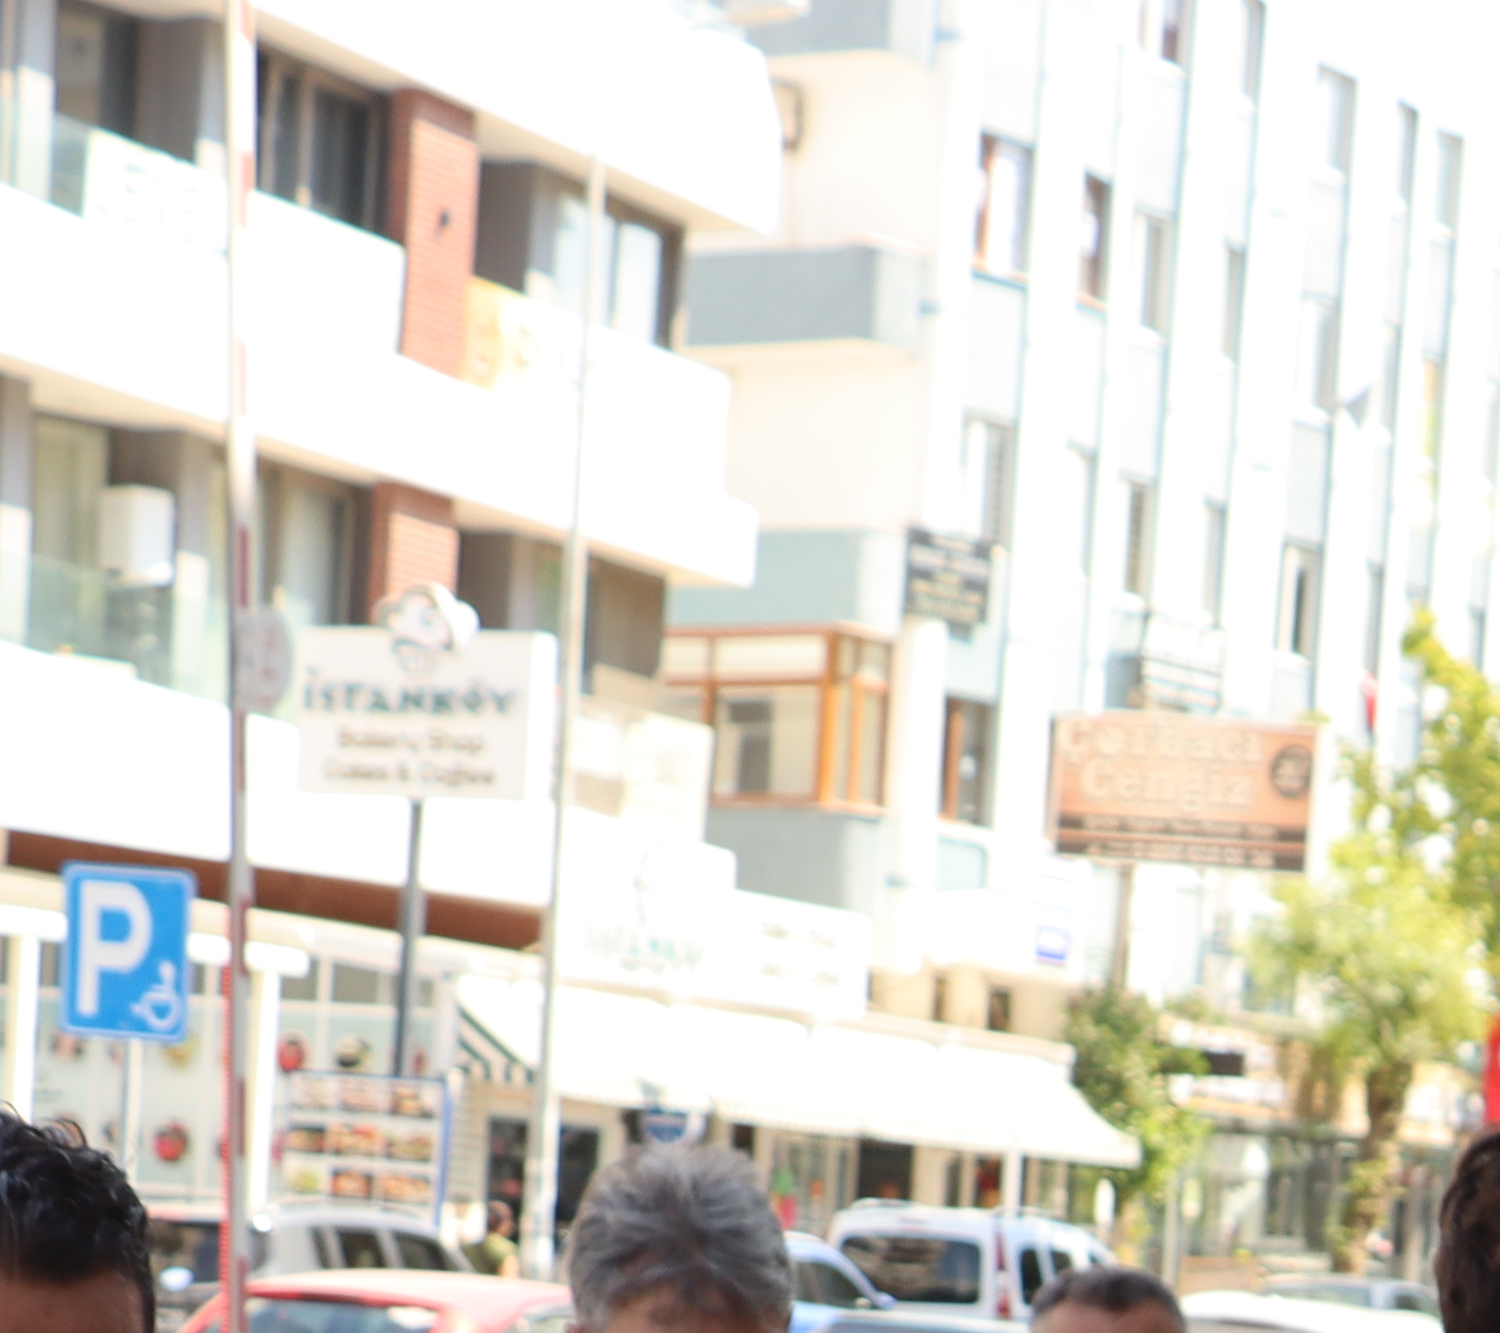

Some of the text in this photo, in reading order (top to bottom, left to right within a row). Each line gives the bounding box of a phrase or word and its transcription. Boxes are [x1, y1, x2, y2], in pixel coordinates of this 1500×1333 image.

[303, 667, 517, 714] İSTANKÖY
[1082, 758, 1254, 814] Cengiz
[76, 879, 152, 1017] P
